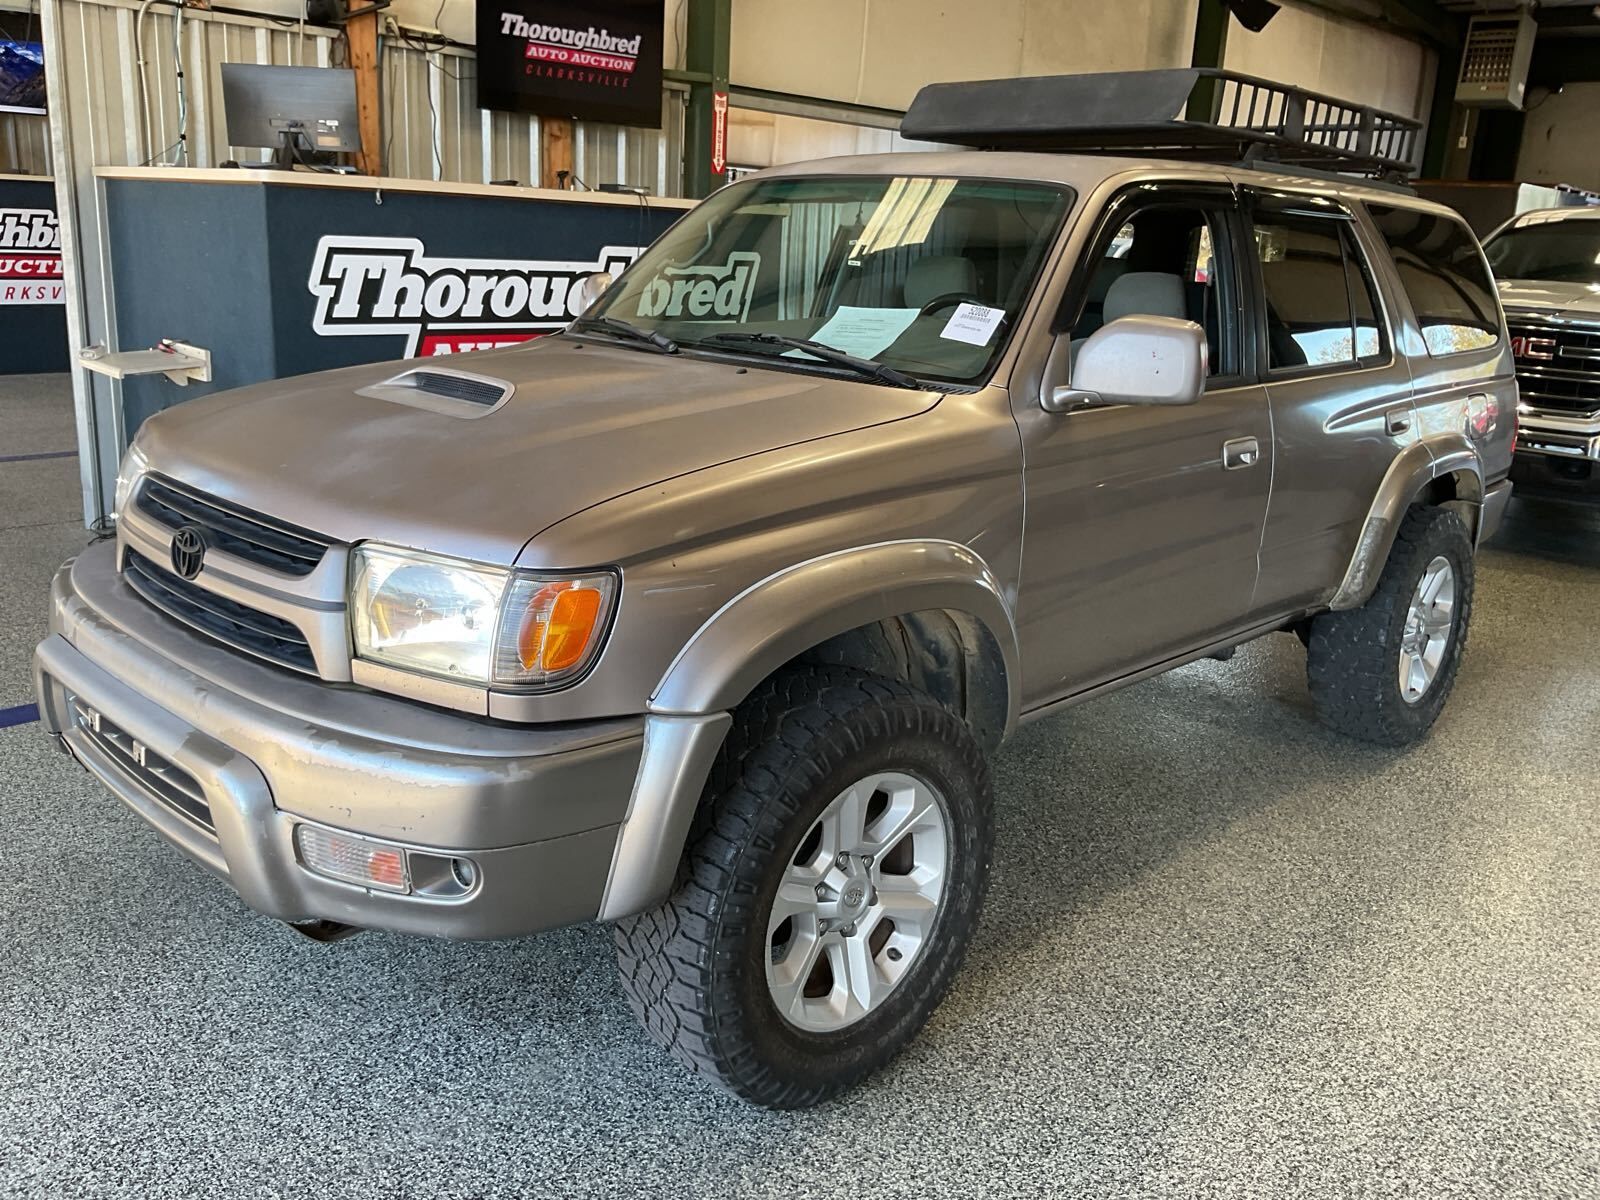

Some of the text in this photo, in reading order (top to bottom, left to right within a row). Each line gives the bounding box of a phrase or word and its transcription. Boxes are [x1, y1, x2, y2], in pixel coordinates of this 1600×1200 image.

[500, 12, 642, 55] Thoroughbred
[527, 46, 635, 71] AUTO AUCTION
[525, 64, 630, 88] CLARKSVILLE
[328, 254, 749, 318] Thoroubred
